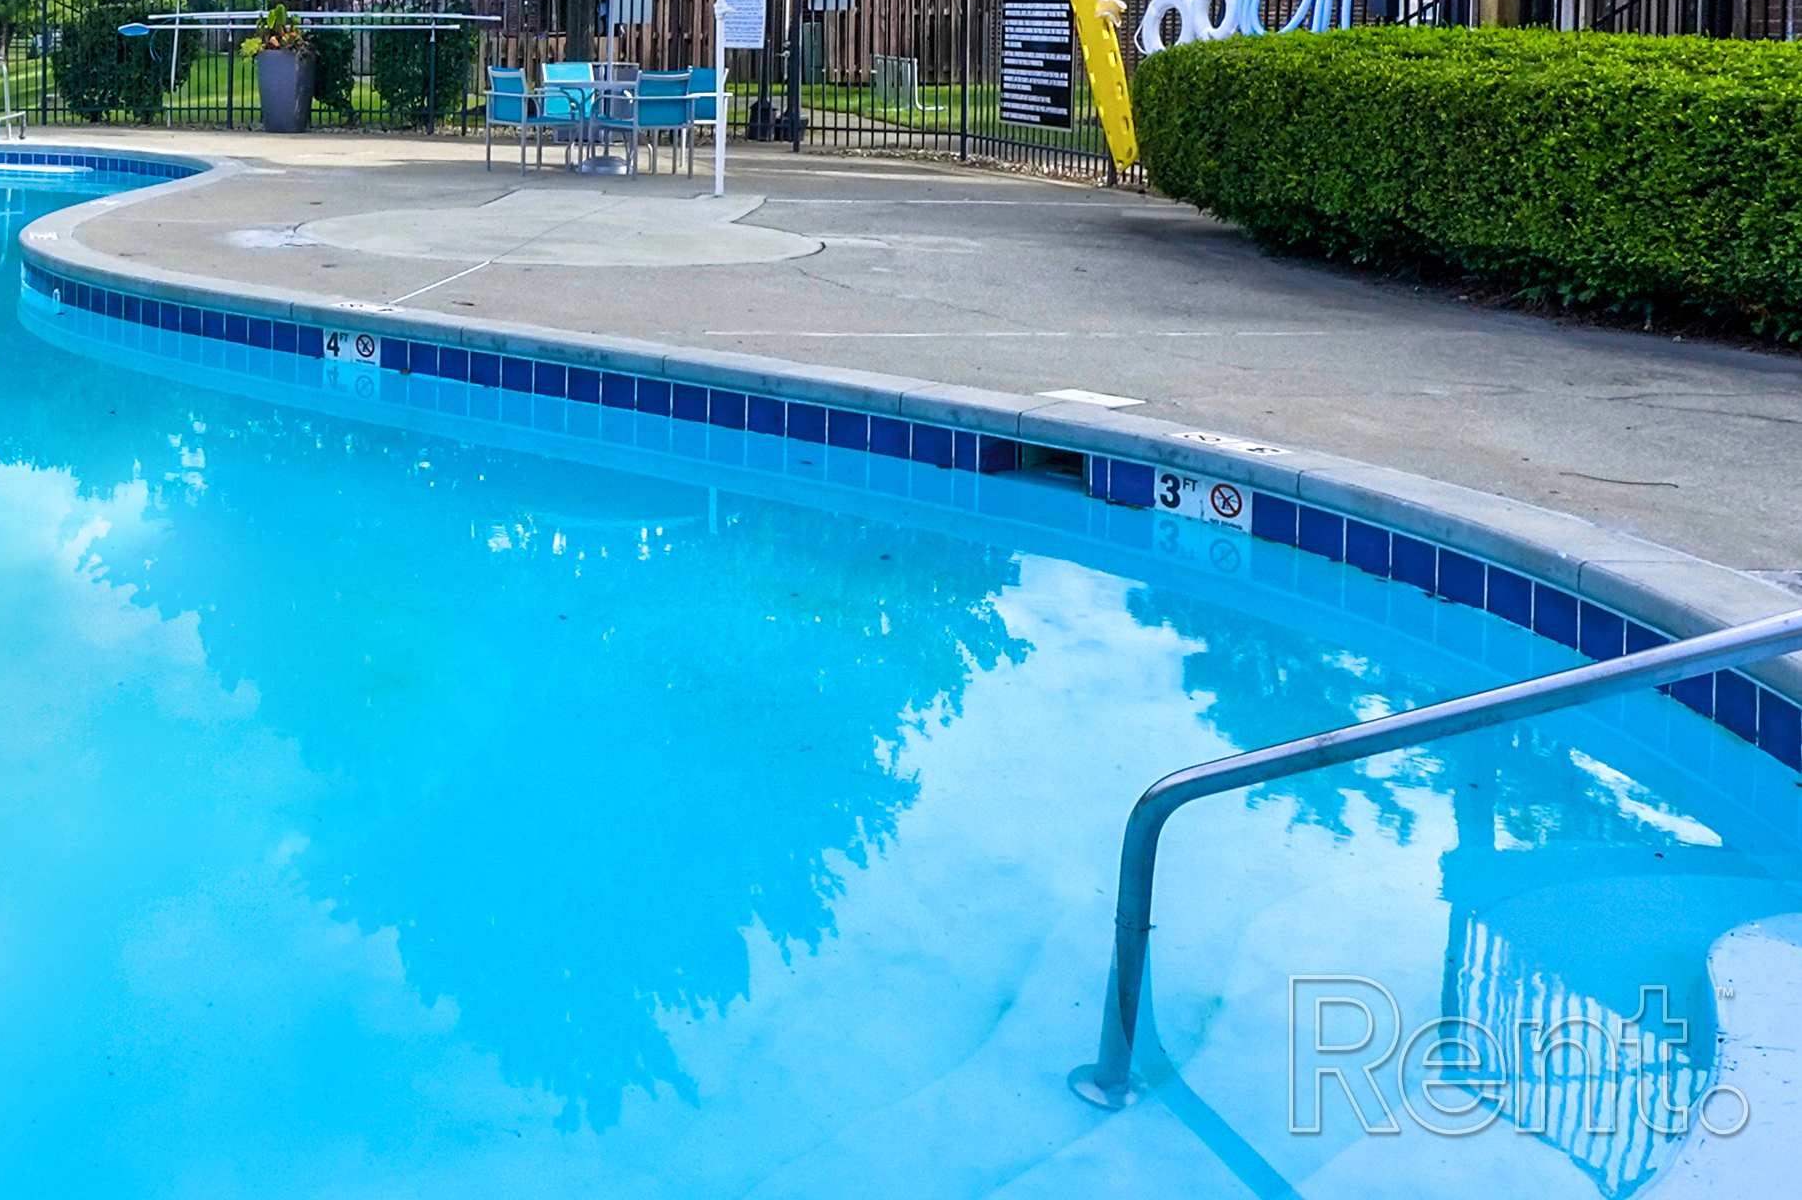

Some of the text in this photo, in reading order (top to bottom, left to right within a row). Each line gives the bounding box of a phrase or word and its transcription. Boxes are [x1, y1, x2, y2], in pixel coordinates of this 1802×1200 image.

[326, 332, 340, 357] 4
[1160, 473, 1198, 509] 3 FT
